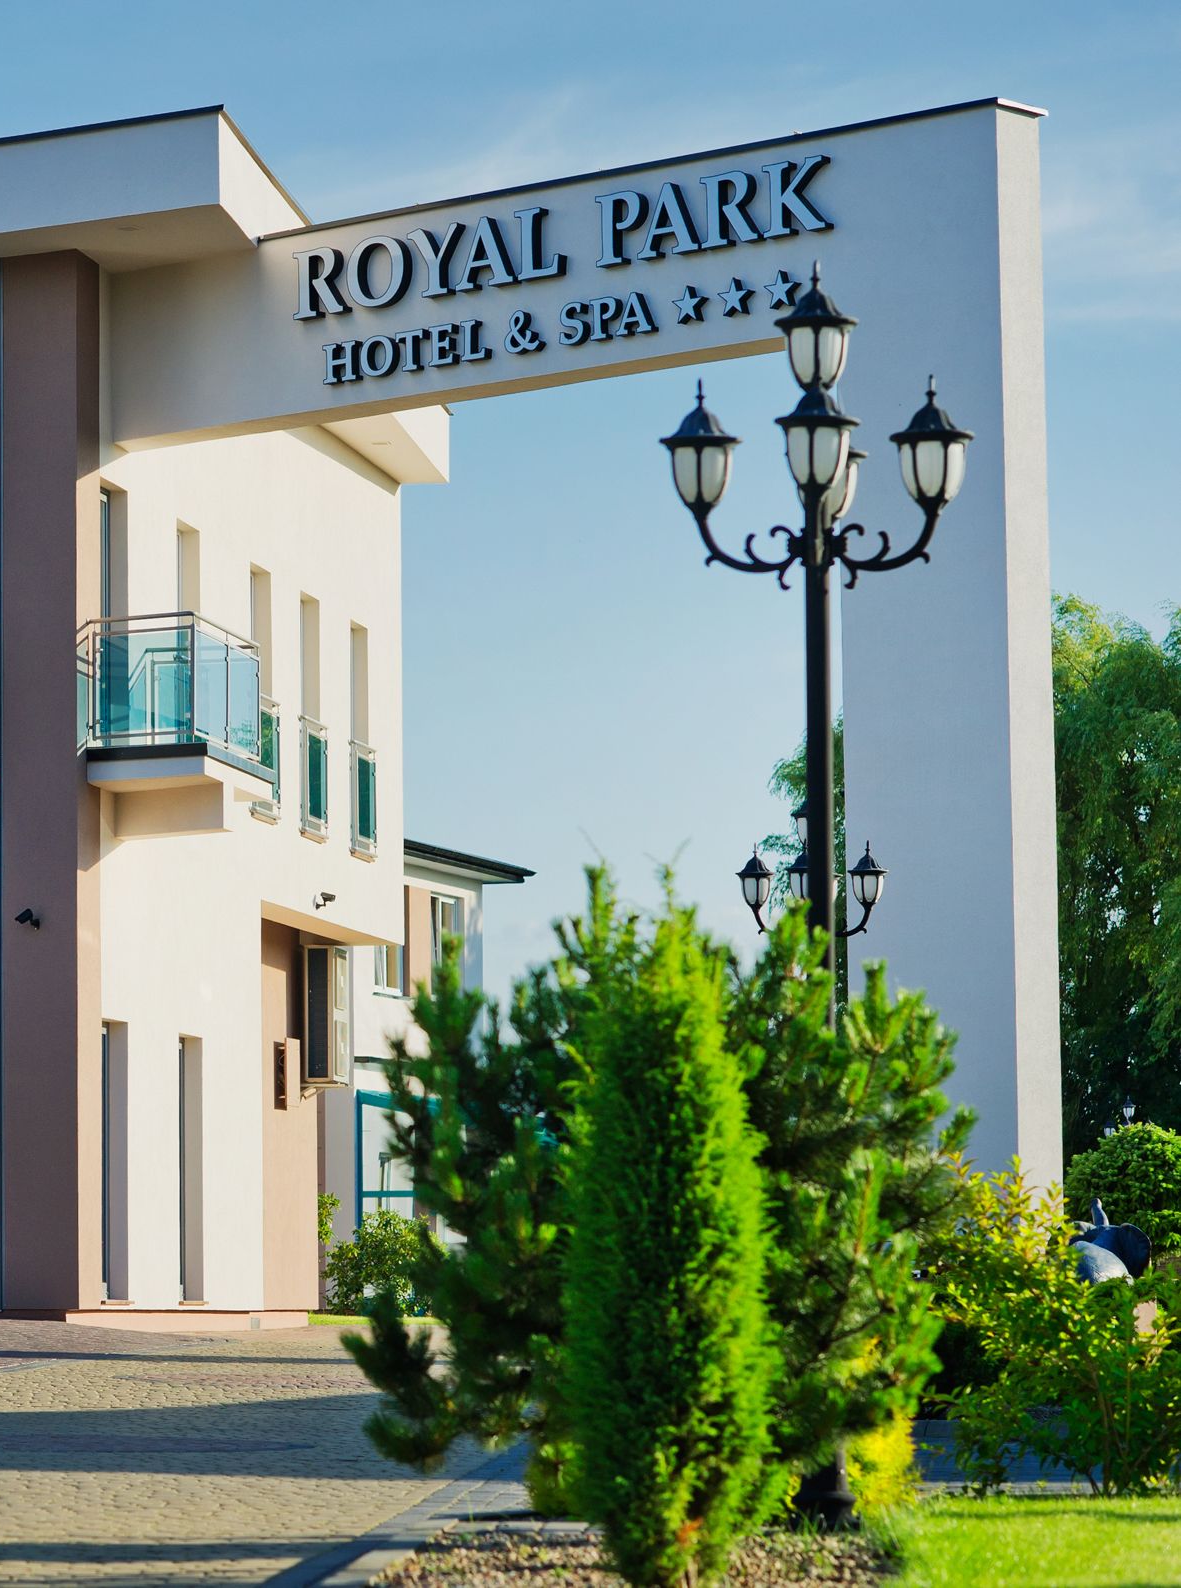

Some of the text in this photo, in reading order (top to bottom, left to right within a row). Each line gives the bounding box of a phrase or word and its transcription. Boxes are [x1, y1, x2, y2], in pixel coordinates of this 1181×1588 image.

[293, 154, 835, 321] ROYAL PARK
[322, 291, 659, 387] HOTEL & SPA
